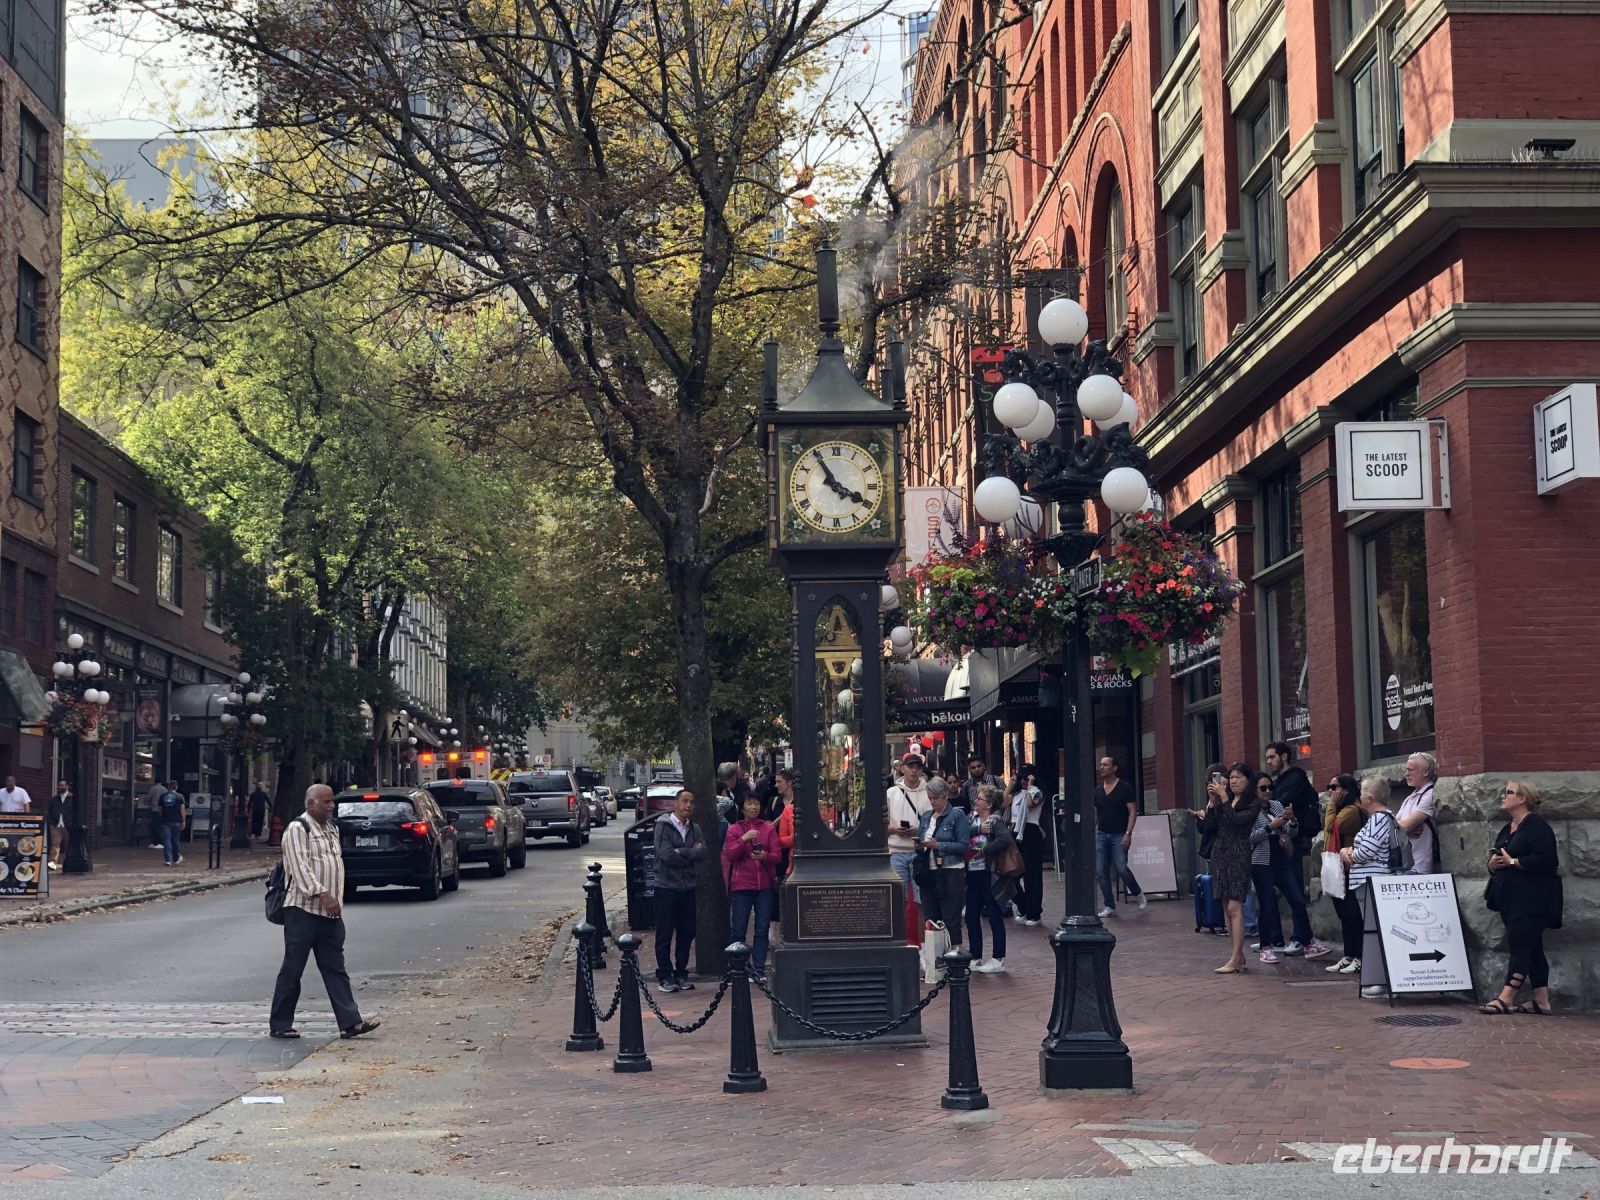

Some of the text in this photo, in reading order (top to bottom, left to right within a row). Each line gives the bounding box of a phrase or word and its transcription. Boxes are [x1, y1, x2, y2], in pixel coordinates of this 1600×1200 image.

[1550, 434, 1568, 454] SCOOP
[1365, 452, 1408, 461] THE LATEST
[1366, 463, 1408, 477] SCOOP
[1096, 681, 1103, 689] &
[1104, 680, 1133, 688] ROCKS
[912, 696, 938, 704] WATER
[1380, 882, 1446, 892] BERTACCHI
